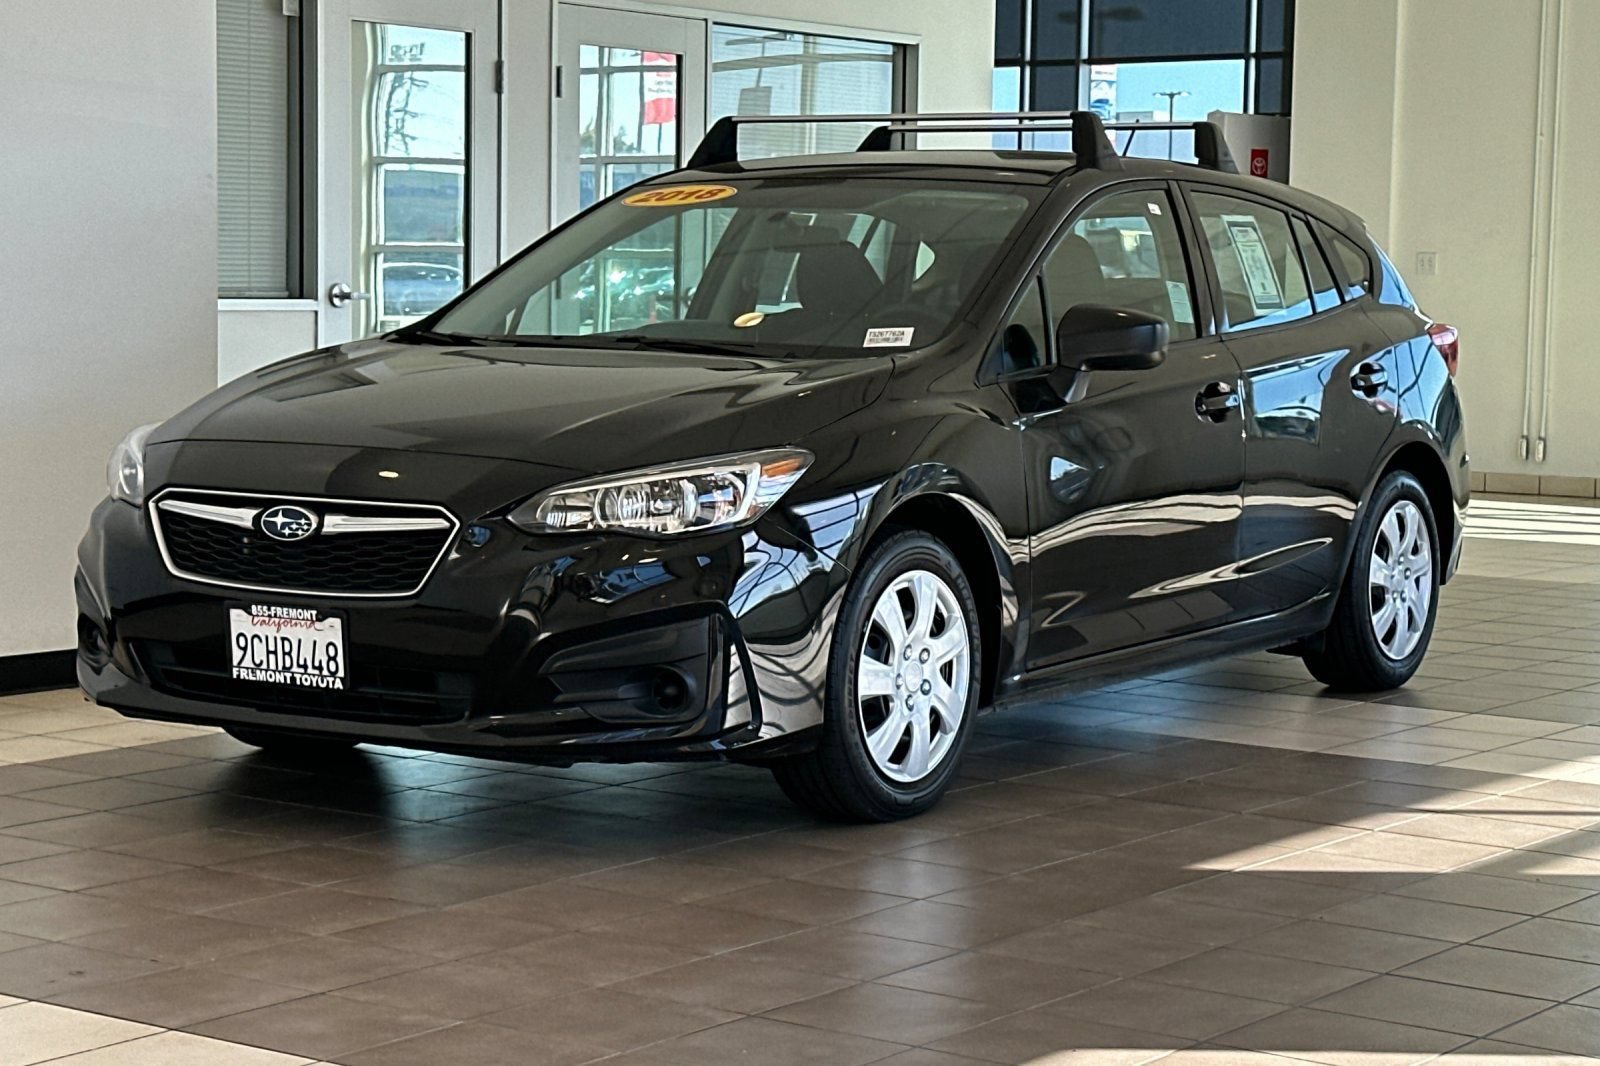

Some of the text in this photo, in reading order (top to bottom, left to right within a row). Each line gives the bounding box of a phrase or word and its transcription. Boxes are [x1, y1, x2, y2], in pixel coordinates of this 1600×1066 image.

[631, 188, 727, 203] 2018
[251, 604, 318, 620] 855-FREMONT
[251, 615, 324, 634] California
[235, 631, 340, 677] 9CHB448
[232, 667, 344, 690] FREMONT TOYOTA
